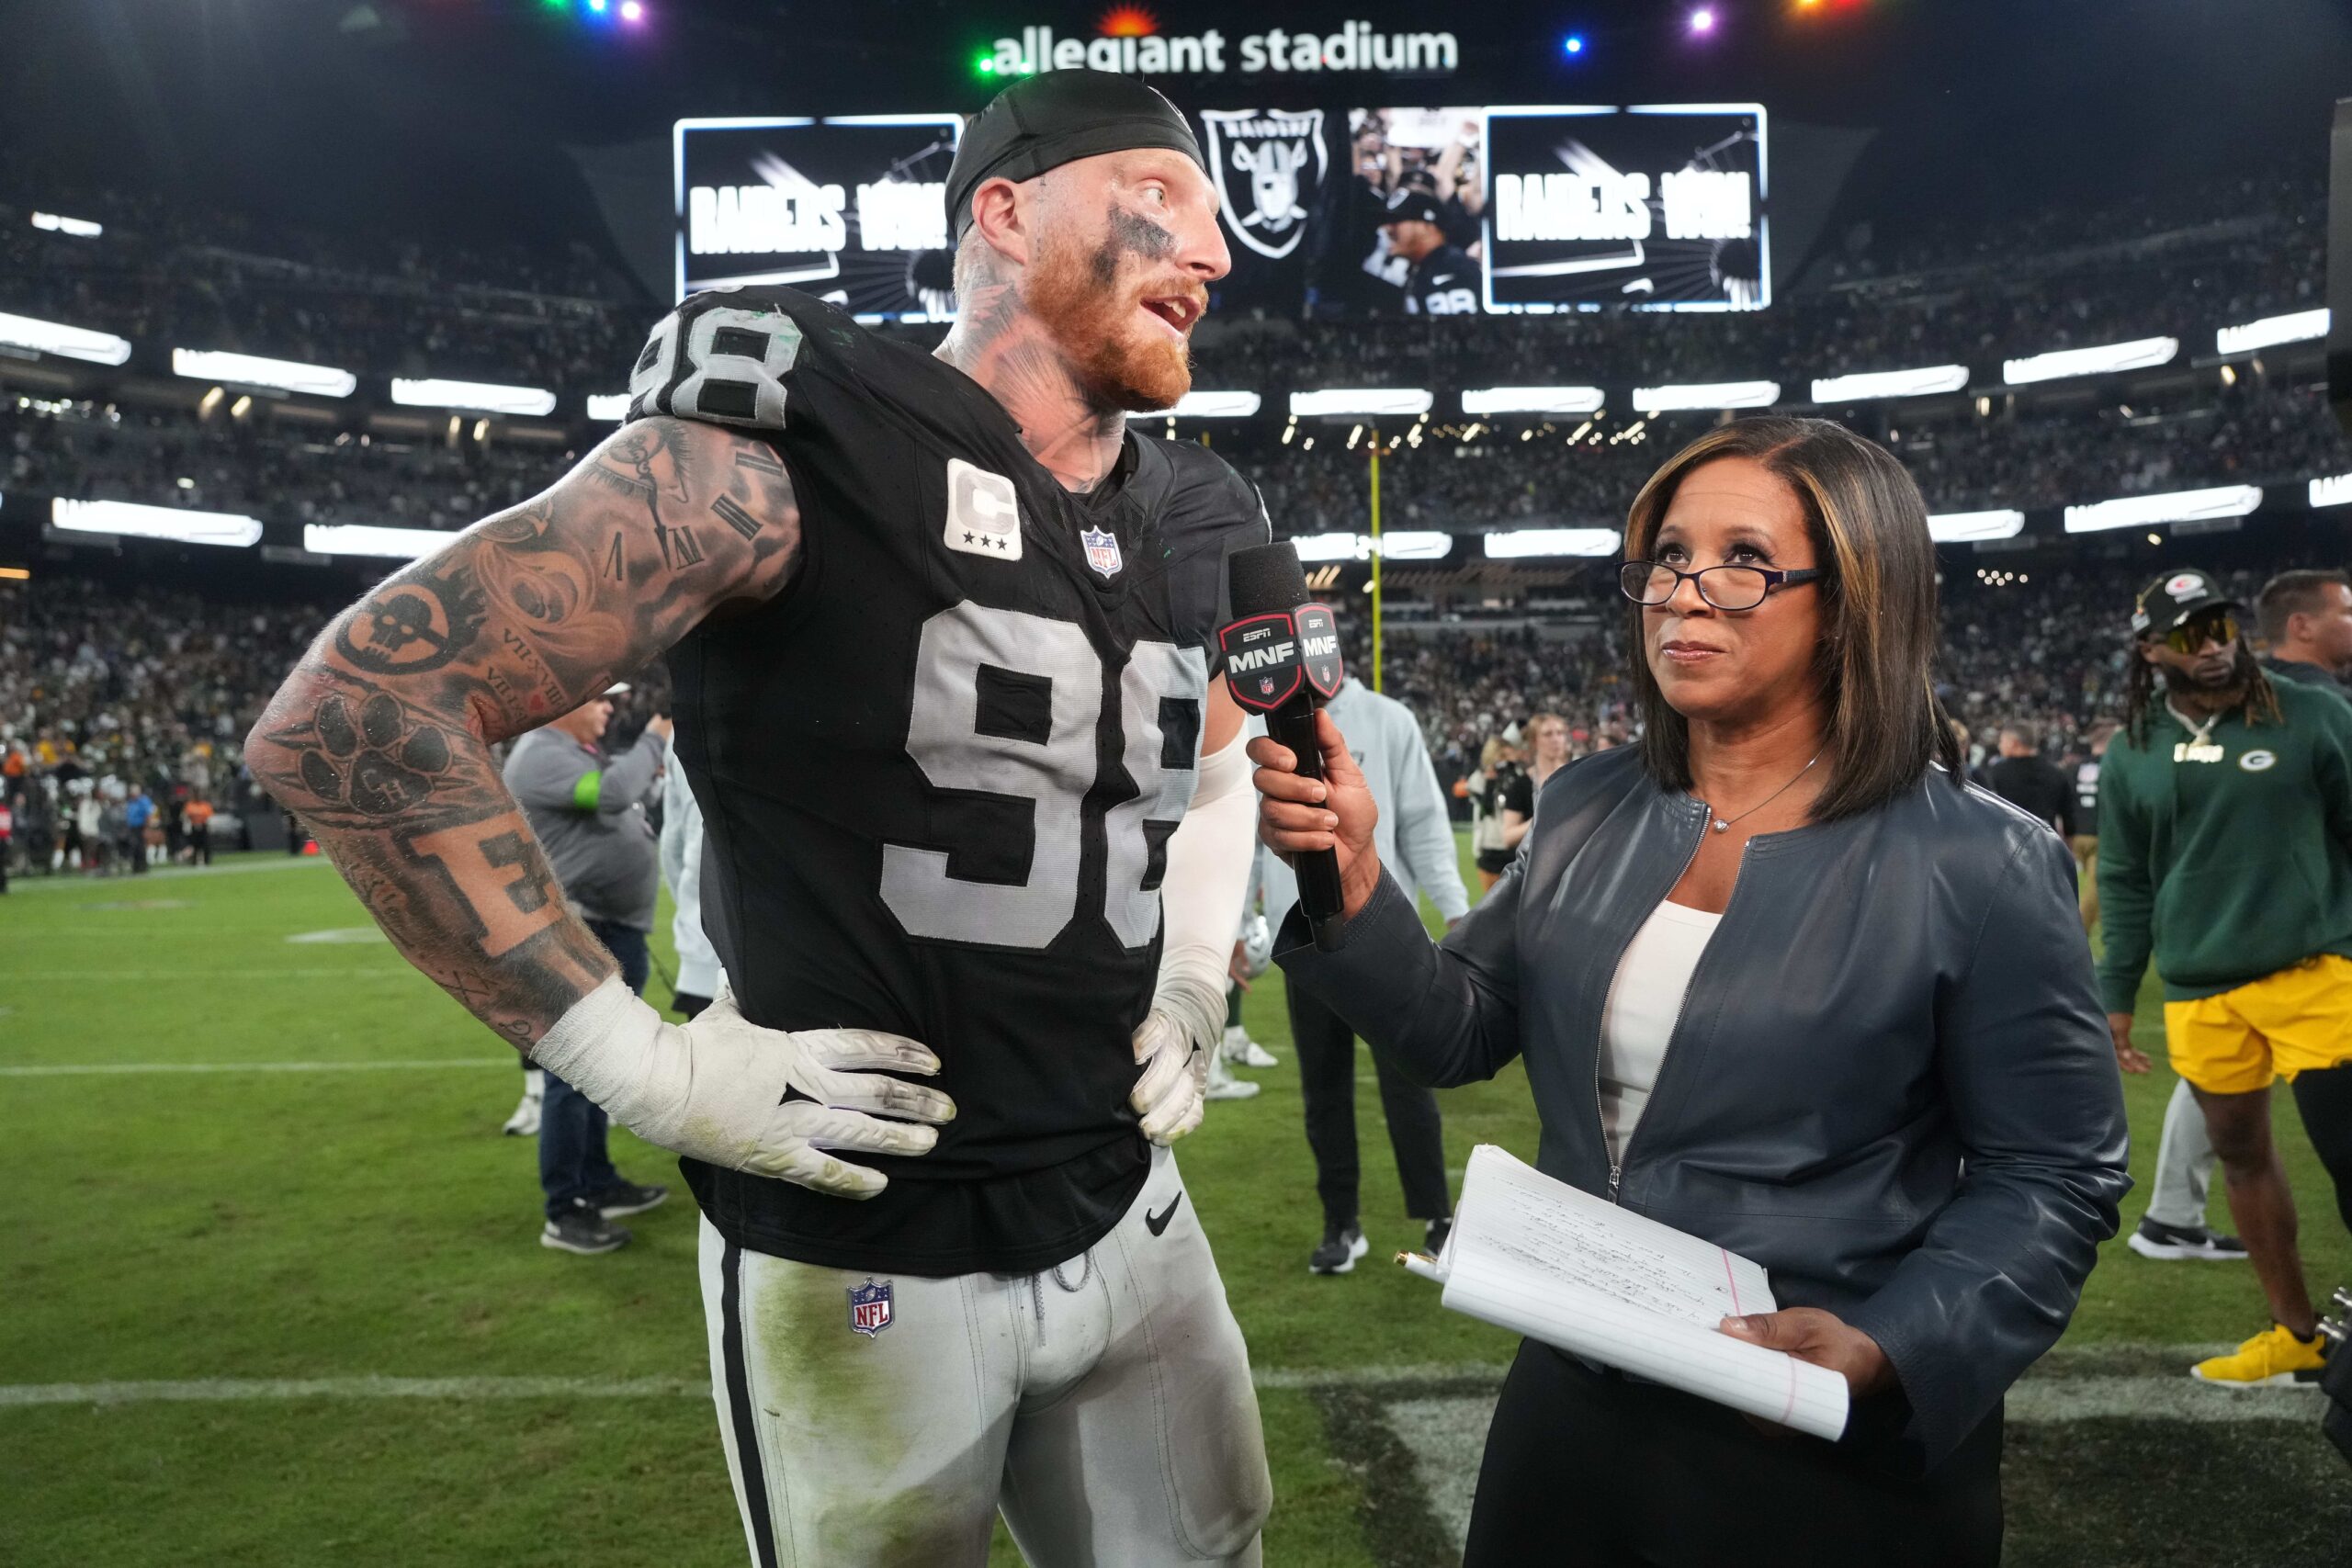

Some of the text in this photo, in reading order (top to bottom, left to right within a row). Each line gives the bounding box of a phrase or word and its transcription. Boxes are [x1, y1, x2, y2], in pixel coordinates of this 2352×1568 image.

[993, 19, 1458, 75] allegiant stadium
[690, 184, 846, 254] RAIDERS
[1496, 172, 1651, 241] RAIDERS
[956, 469, 1015, 536] C
[1090, 548, 1117, 569] NFL
[1243, 627, 1271, 643] ESPN
[1303, 635, 1337, 658] MNF
[1228, 641, 1295, 674] MNF
[879, 599, 1209, 950] 98
[855, 1302, 889, 1327] NFL
